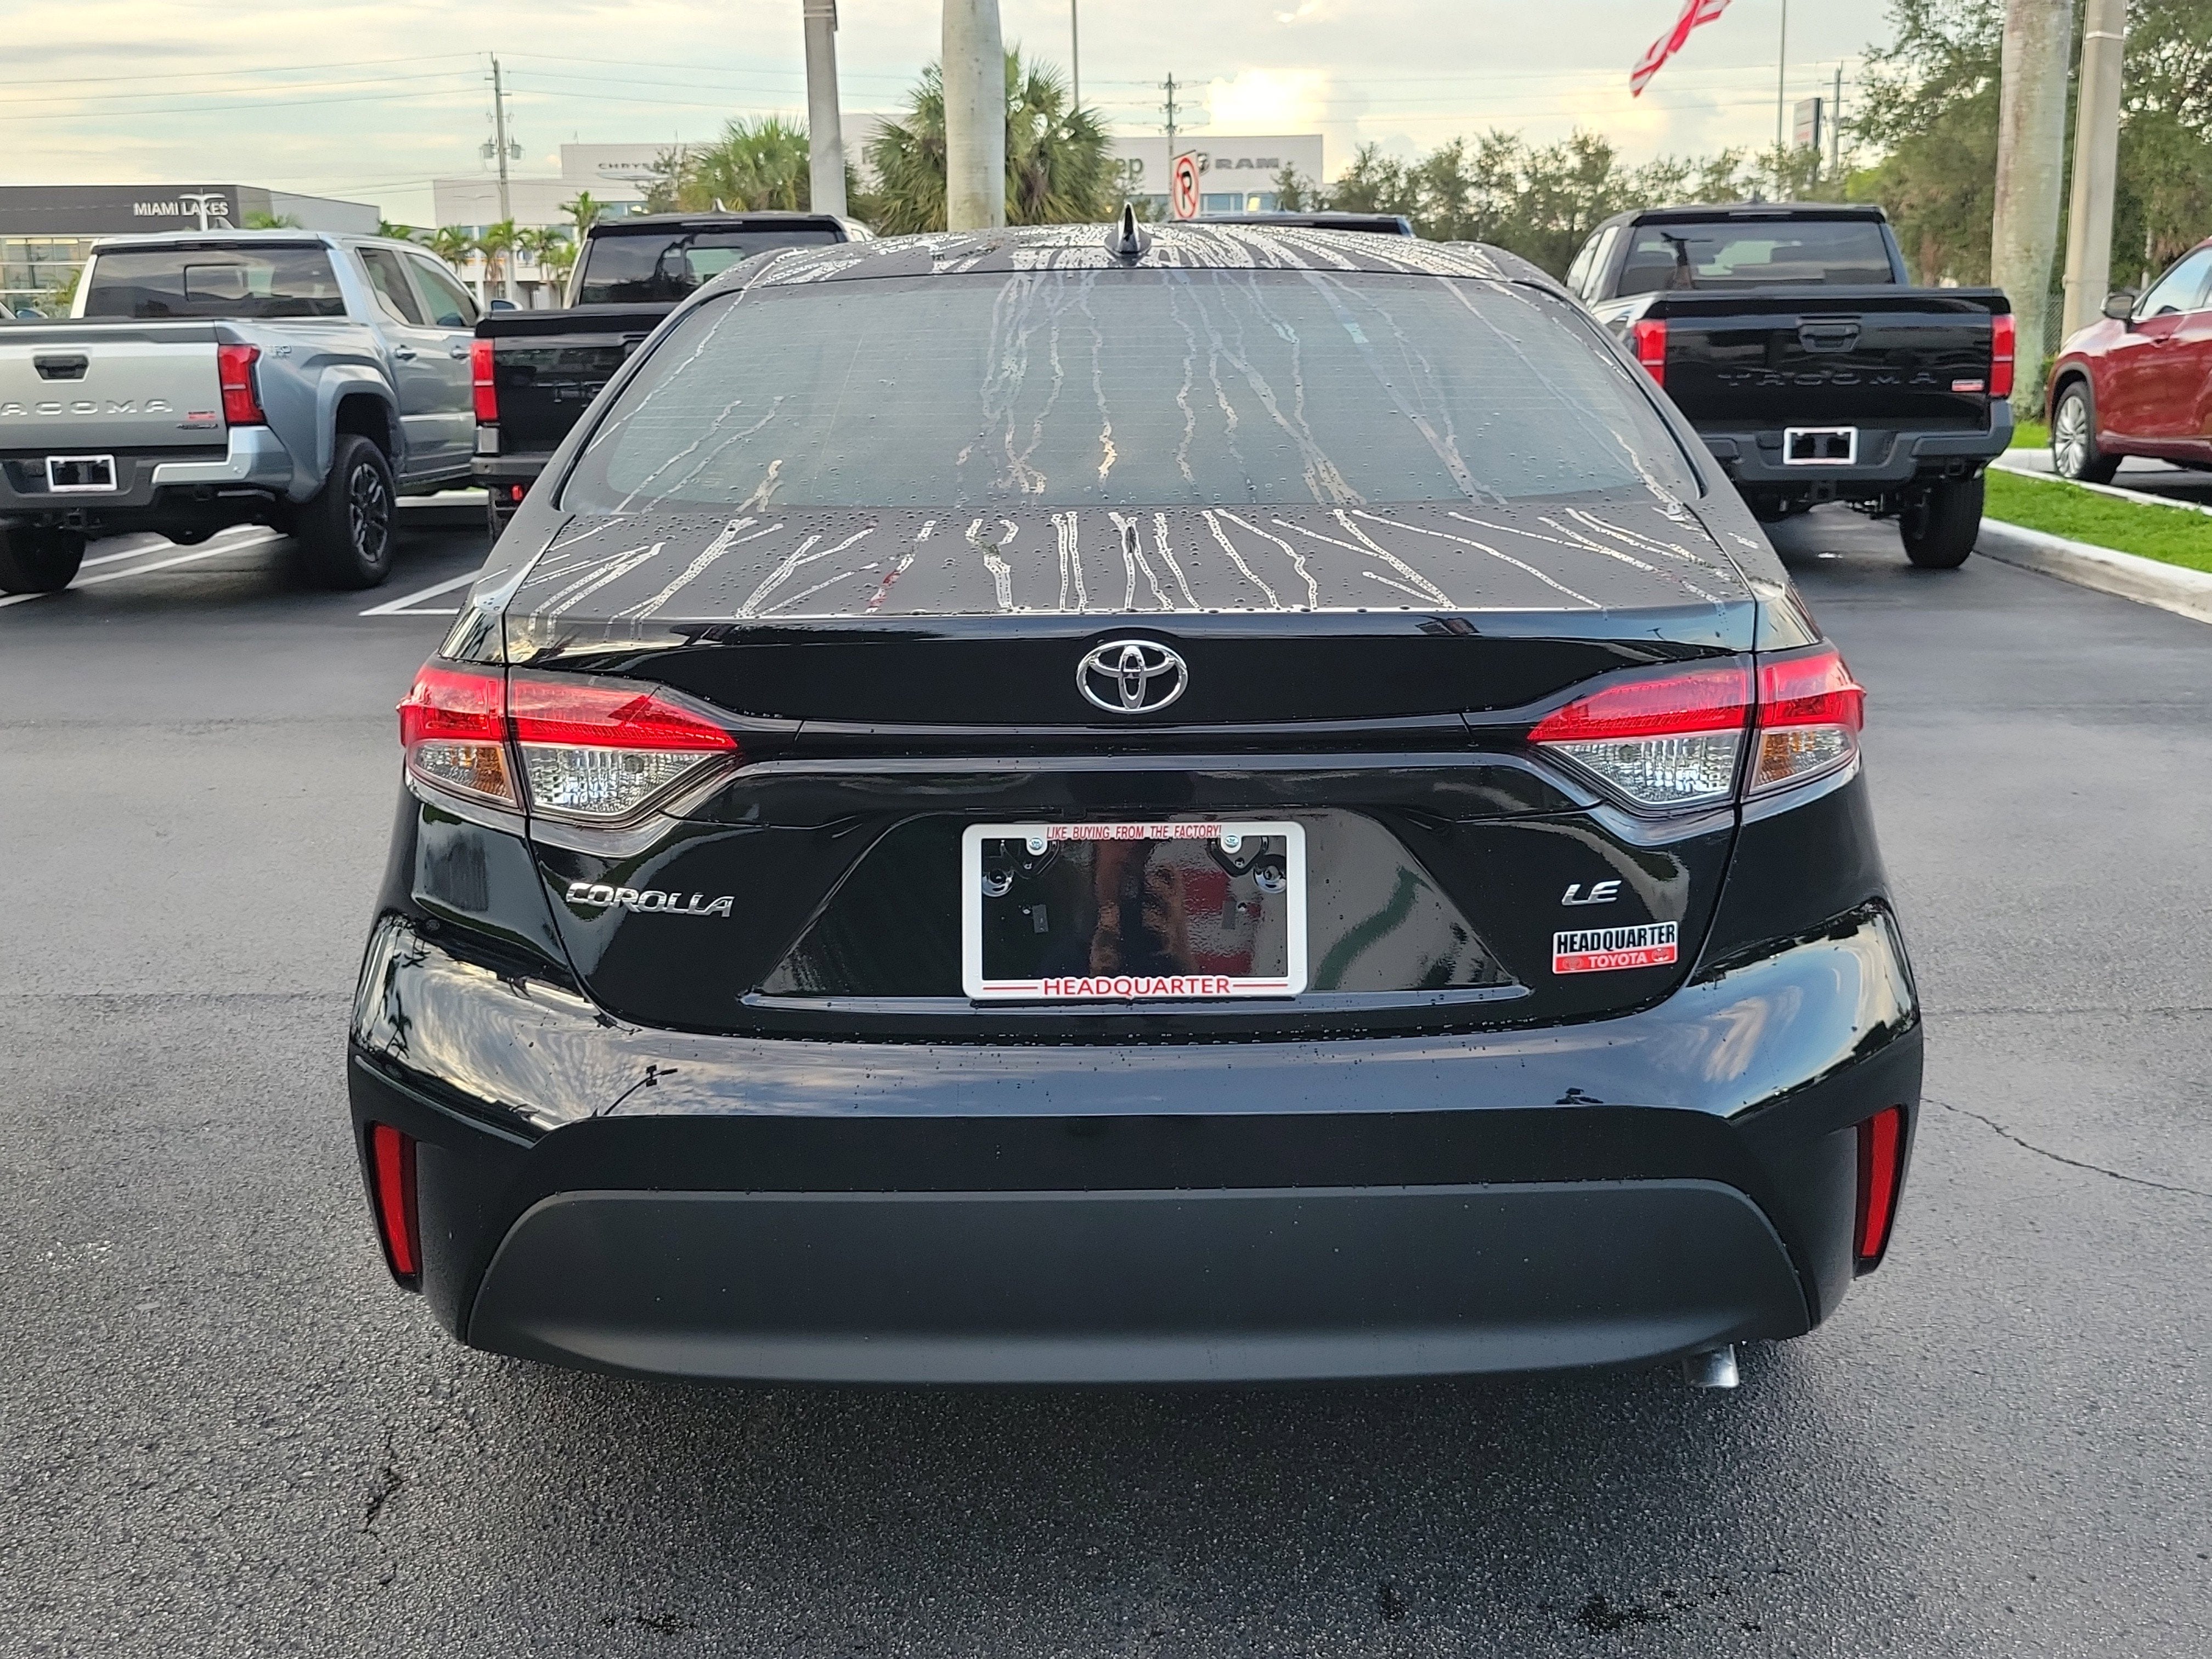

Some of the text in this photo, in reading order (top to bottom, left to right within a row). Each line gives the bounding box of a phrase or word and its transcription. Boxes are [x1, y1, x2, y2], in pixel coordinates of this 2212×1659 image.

[1215, 158, 1279, 169] RAM
[133, 202, 229, 216] MIAMI LAKES
[1717, 373, 1938, 386] TACOMA
[0, 399, 173, 416] ACOMA
[1046, 825, 1222, 839] LIKE BUYING FROM THE FACTORY!
[566, 882, 735, 917] COROLLA
[1561, 880, 1622, 905] LE
[1557, 924, 1675, 954] HEADQUARTER
[1588, 952, 1647, 968] TOYOTA
[1044, 978, 1231, 996] HEADQUARTER
